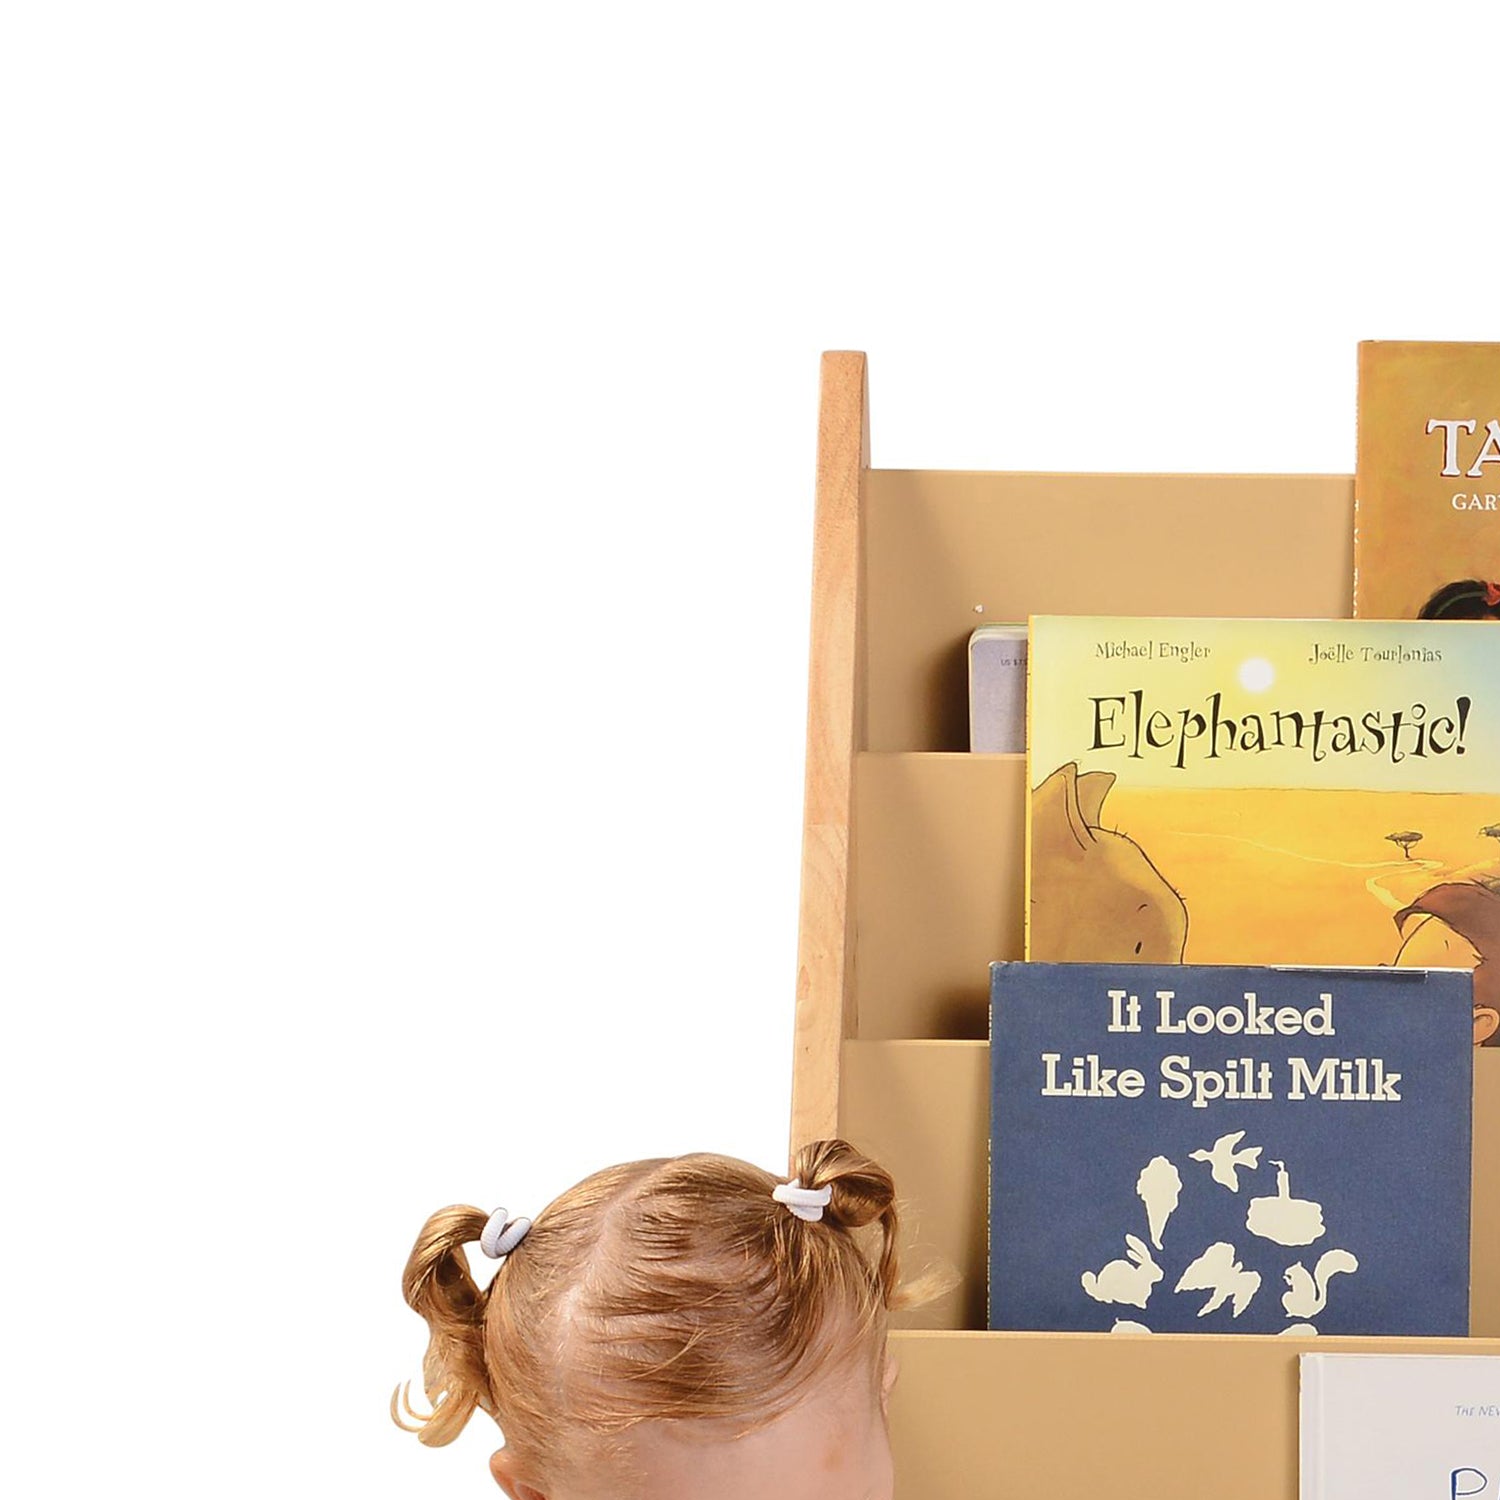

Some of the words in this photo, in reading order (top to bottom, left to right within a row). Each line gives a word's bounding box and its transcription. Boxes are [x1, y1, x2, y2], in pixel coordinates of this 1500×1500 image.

[1095, 641, 1153, 660] Michael
[1158, 642, 1211, 663] Engler
[1086, 689, 1472, 770] Elephantastic!
[1106, 989, 1142, 1033] It
[1155, 990, 1336, 1037] Looked
[1041, 1053, 1146, 1099] Like
[1160, 1054, 1273, 1109] Spilt
[1287, 1057, 1402, 1102] Milk
